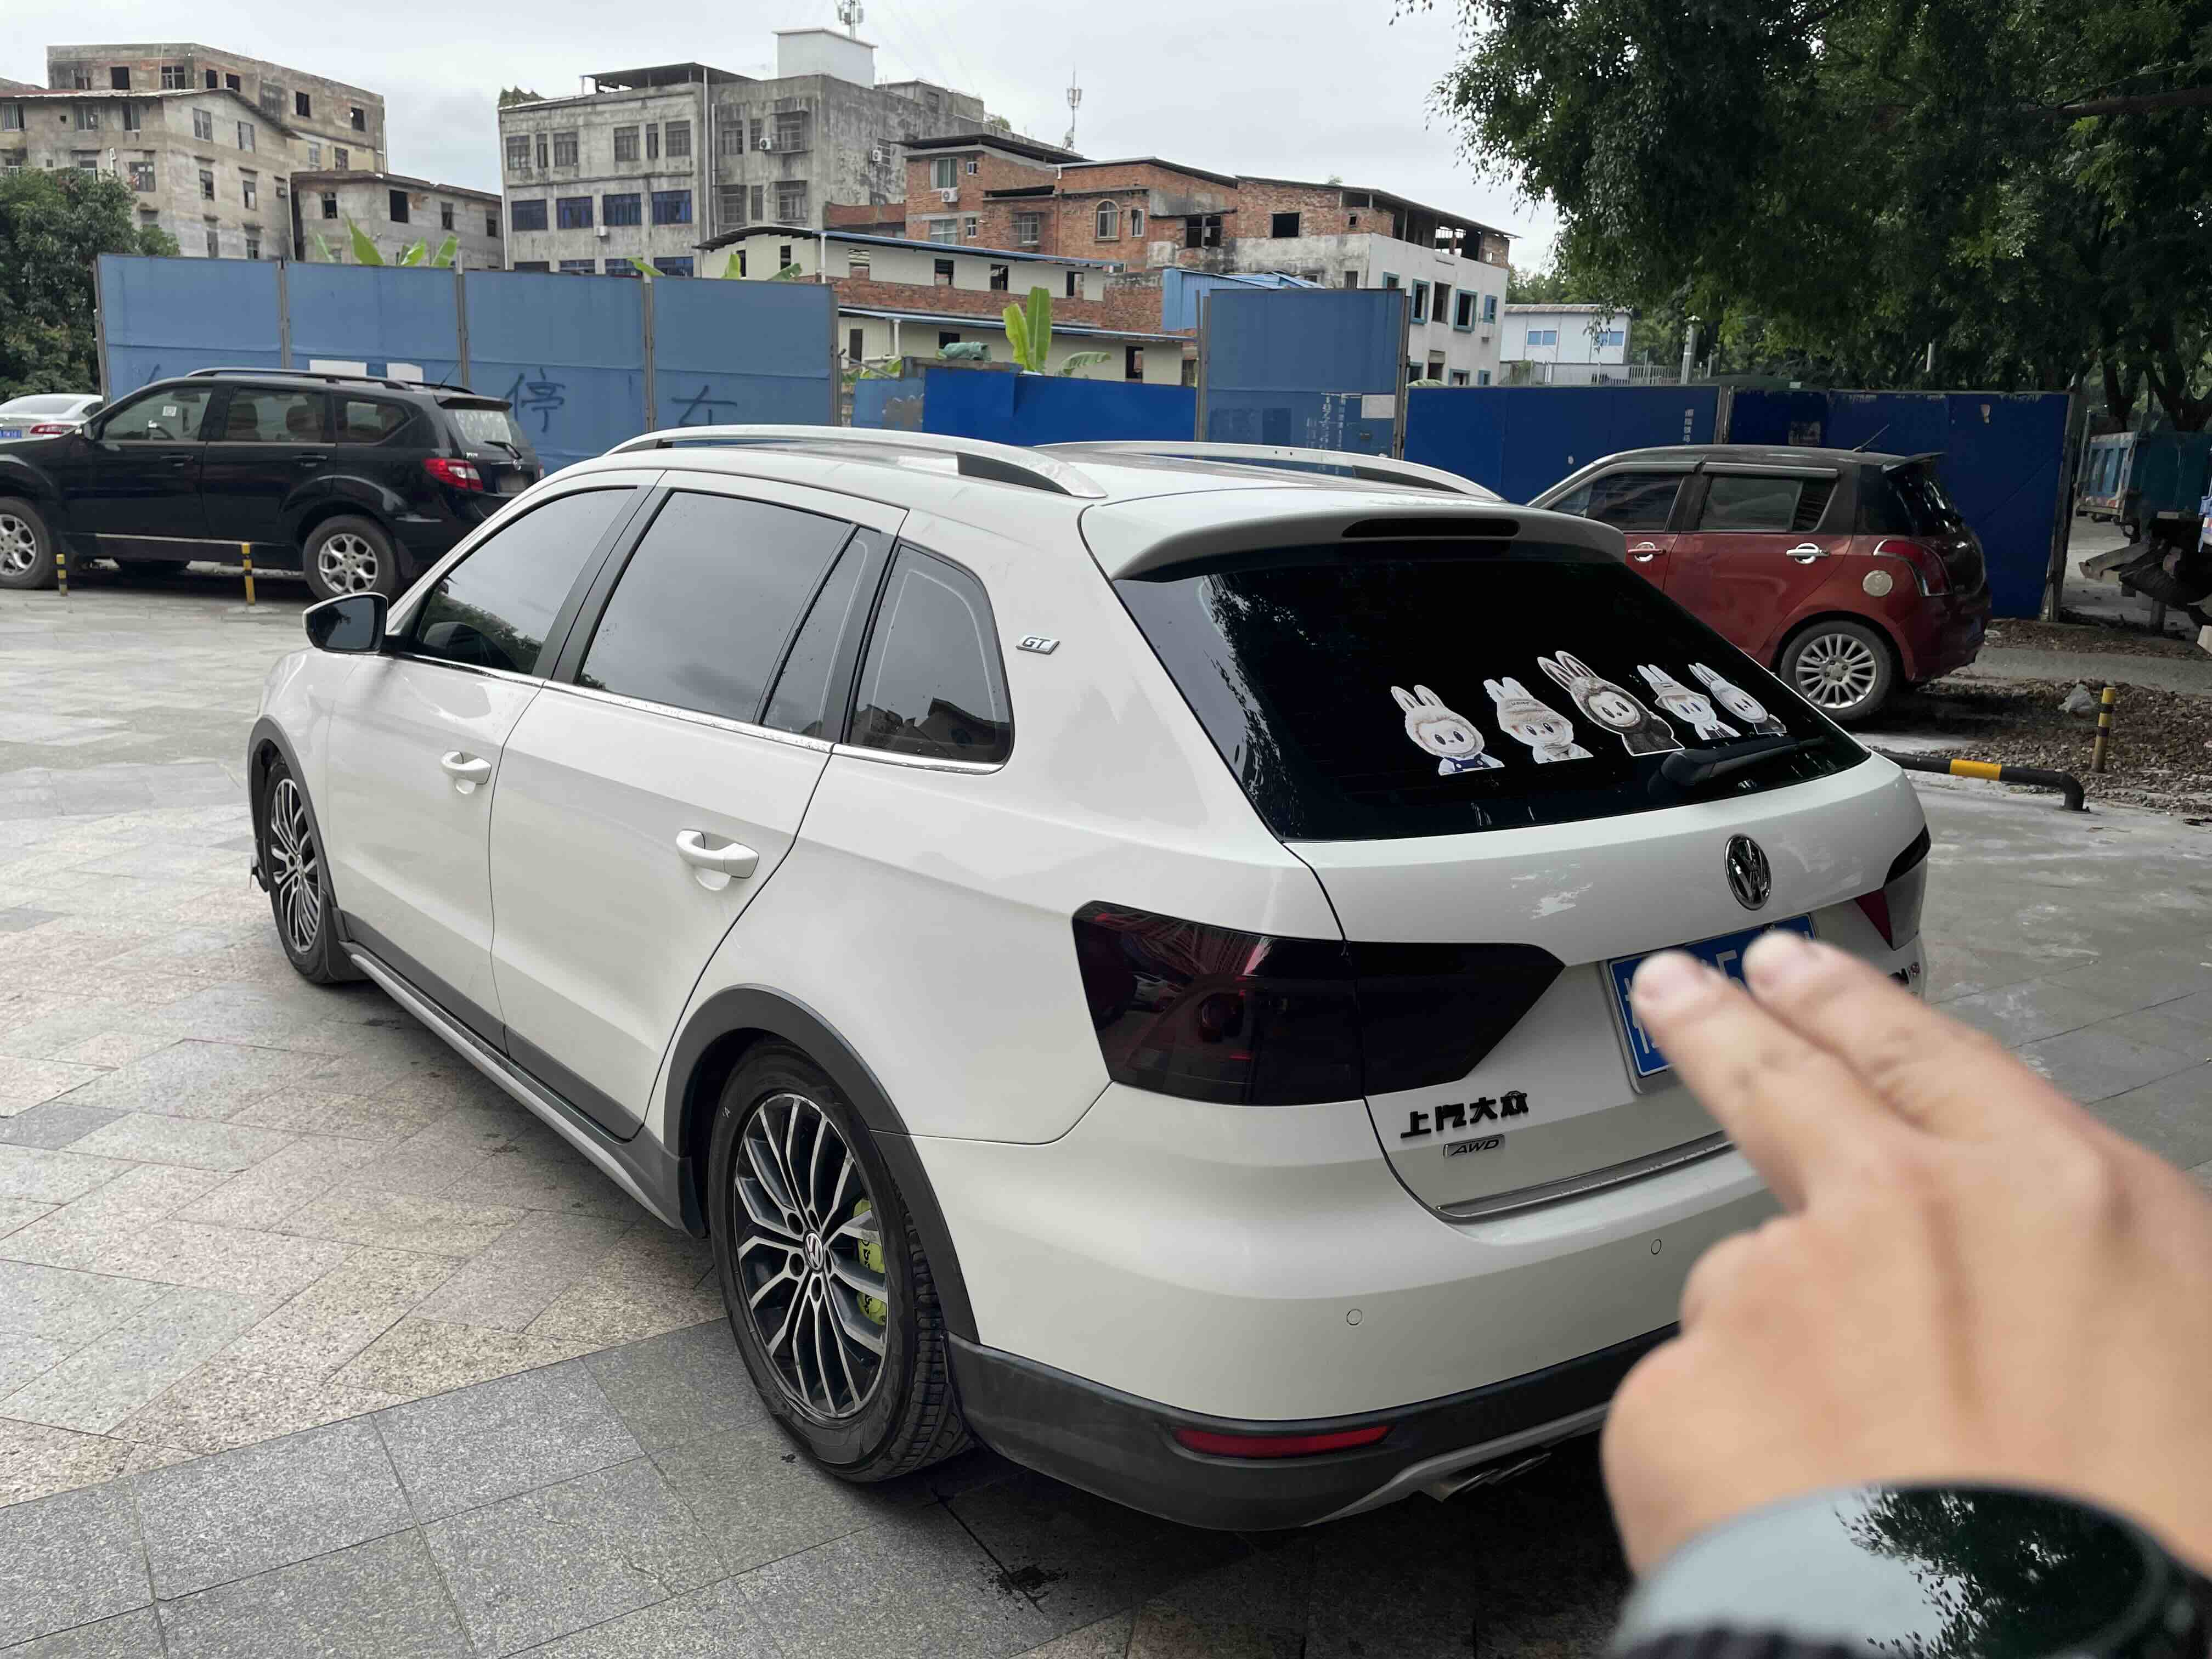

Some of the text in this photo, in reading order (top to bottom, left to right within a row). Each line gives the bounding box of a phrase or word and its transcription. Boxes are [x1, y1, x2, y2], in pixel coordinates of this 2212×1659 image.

[1022, 637, 1051, 649] GT
[1400, 1091, 1529, 1139] 上汽大众
[1450, 1138, 1499, 1156] AWD
